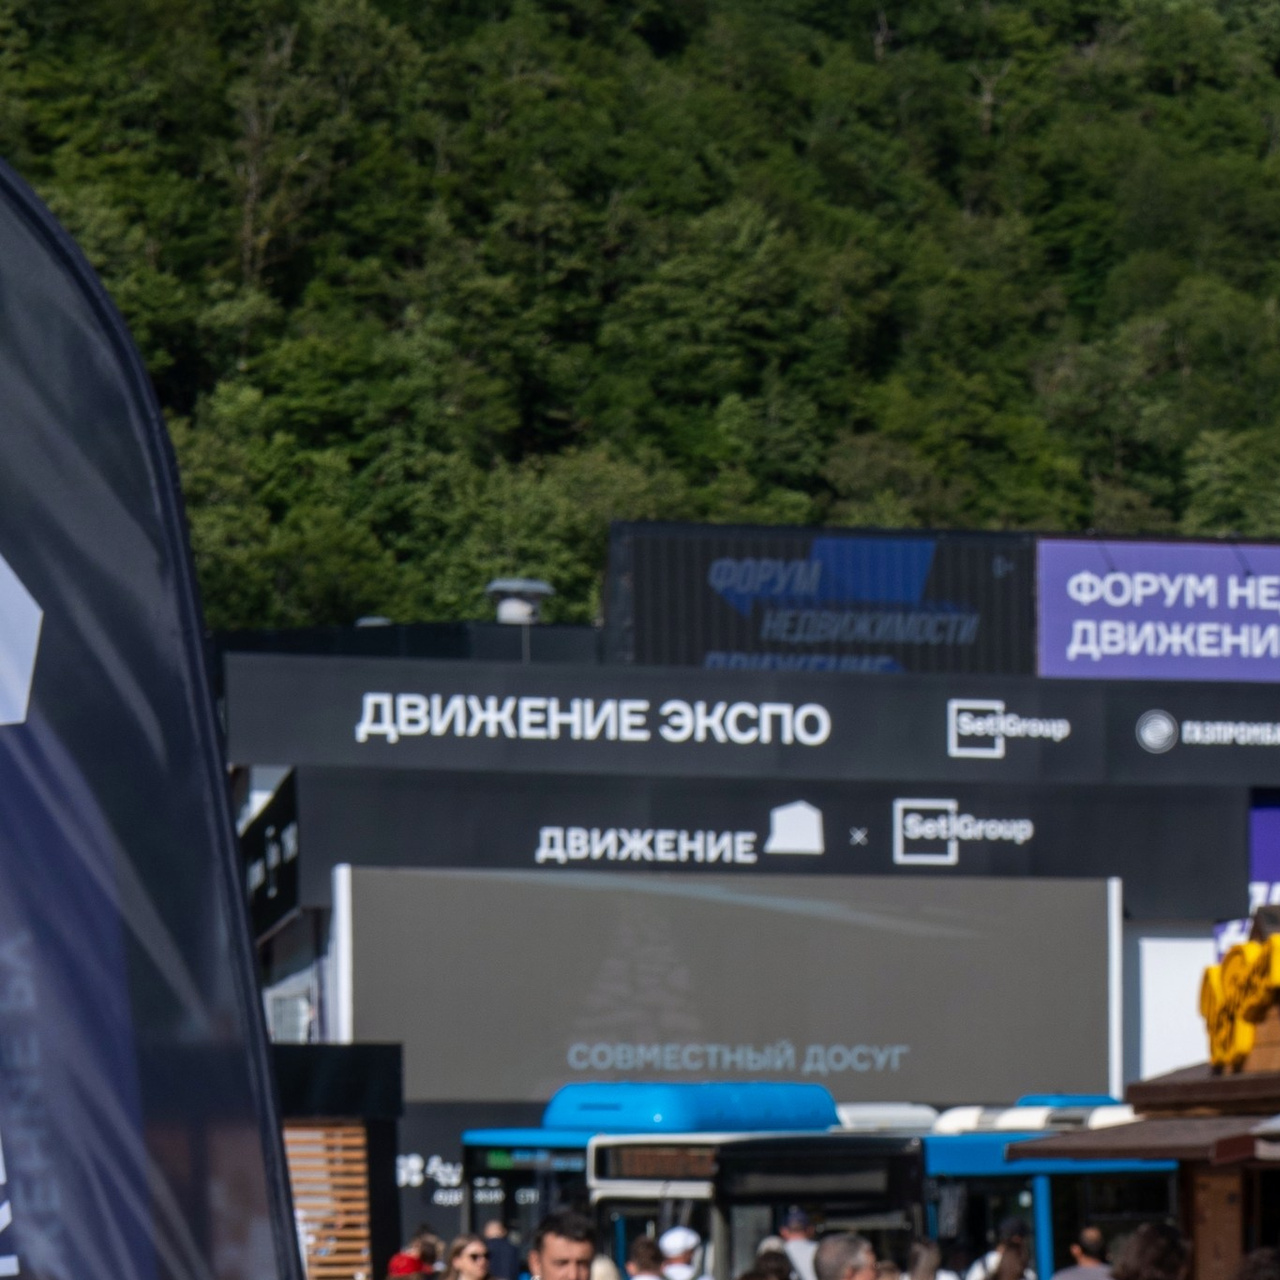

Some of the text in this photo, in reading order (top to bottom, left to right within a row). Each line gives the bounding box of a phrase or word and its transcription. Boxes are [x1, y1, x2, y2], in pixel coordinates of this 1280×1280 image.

[708, 558, 822, 595] ФОРУМ
[1067, 571, 1216, 608] ФОРУМ
[761, 610, 981, 647] НЕДВИЖИМОСТИ
[355, 692, 833, 748] ДВИЖЕНИЕ ЭКСПО
[535, 826, 758, 865] ДВИЖЕНИЕ
[567, 1038, 911, 1078] СОВМЕСТНЫЙ ДОСУГ
